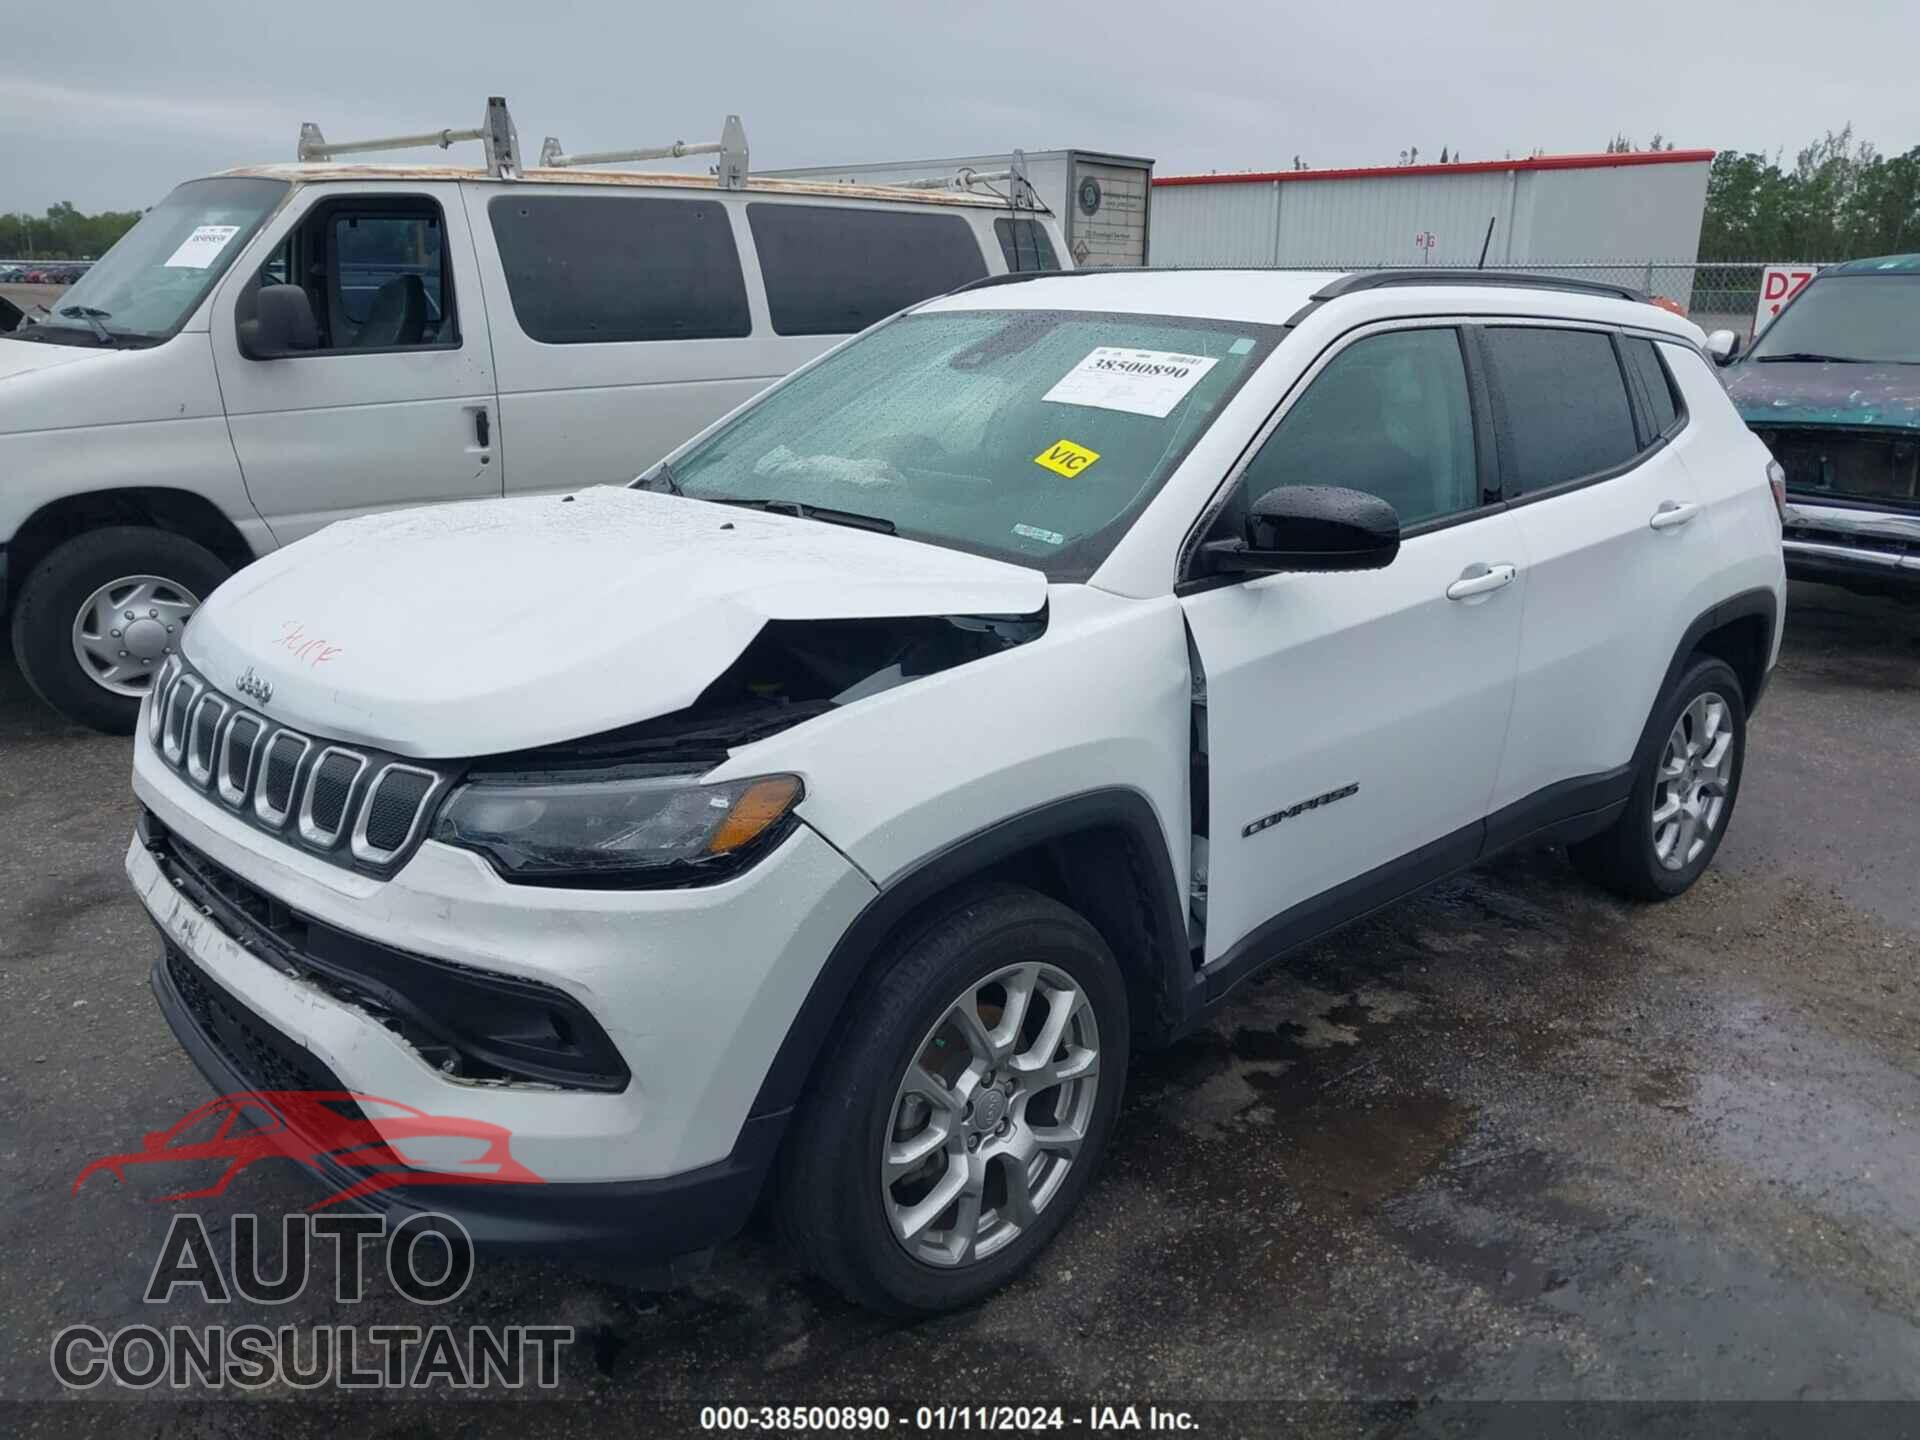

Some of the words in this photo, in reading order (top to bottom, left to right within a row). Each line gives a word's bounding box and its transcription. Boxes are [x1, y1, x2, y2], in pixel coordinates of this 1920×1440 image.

[1764, 272, 1812, 300] D7
[1088, 359, 1190, 379] 38500890
[1048, 446, 1088, 471] VIC
[235, 666, 273, 707] Jeep
[1241, 781, 1360, 838] COMPASS
